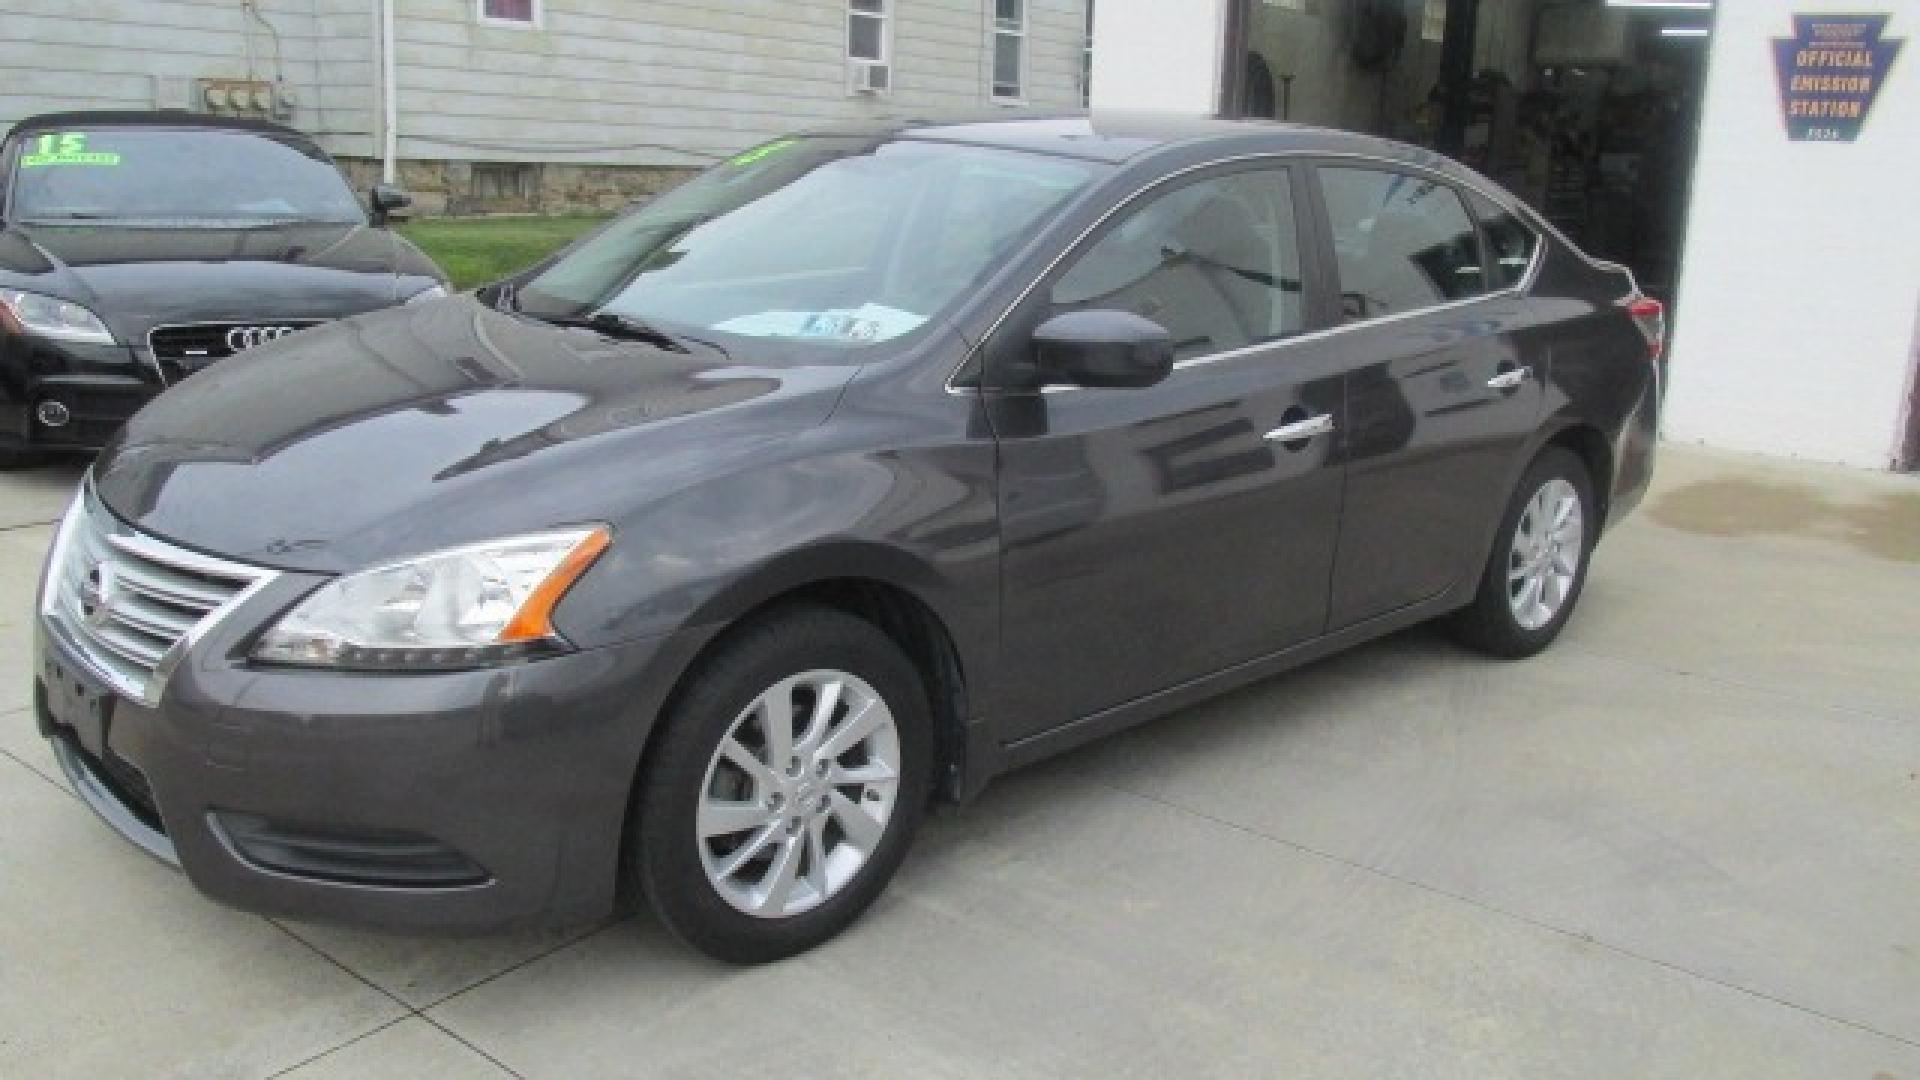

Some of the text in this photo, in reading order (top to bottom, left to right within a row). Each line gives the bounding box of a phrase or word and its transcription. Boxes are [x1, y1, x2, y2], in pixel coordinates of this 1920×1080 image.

[1796, 49, 1873, 68] OFFICIAL
[1790, 75, 1872, 93] EMISSION
[1789, 100, 1861, 118] STATION
